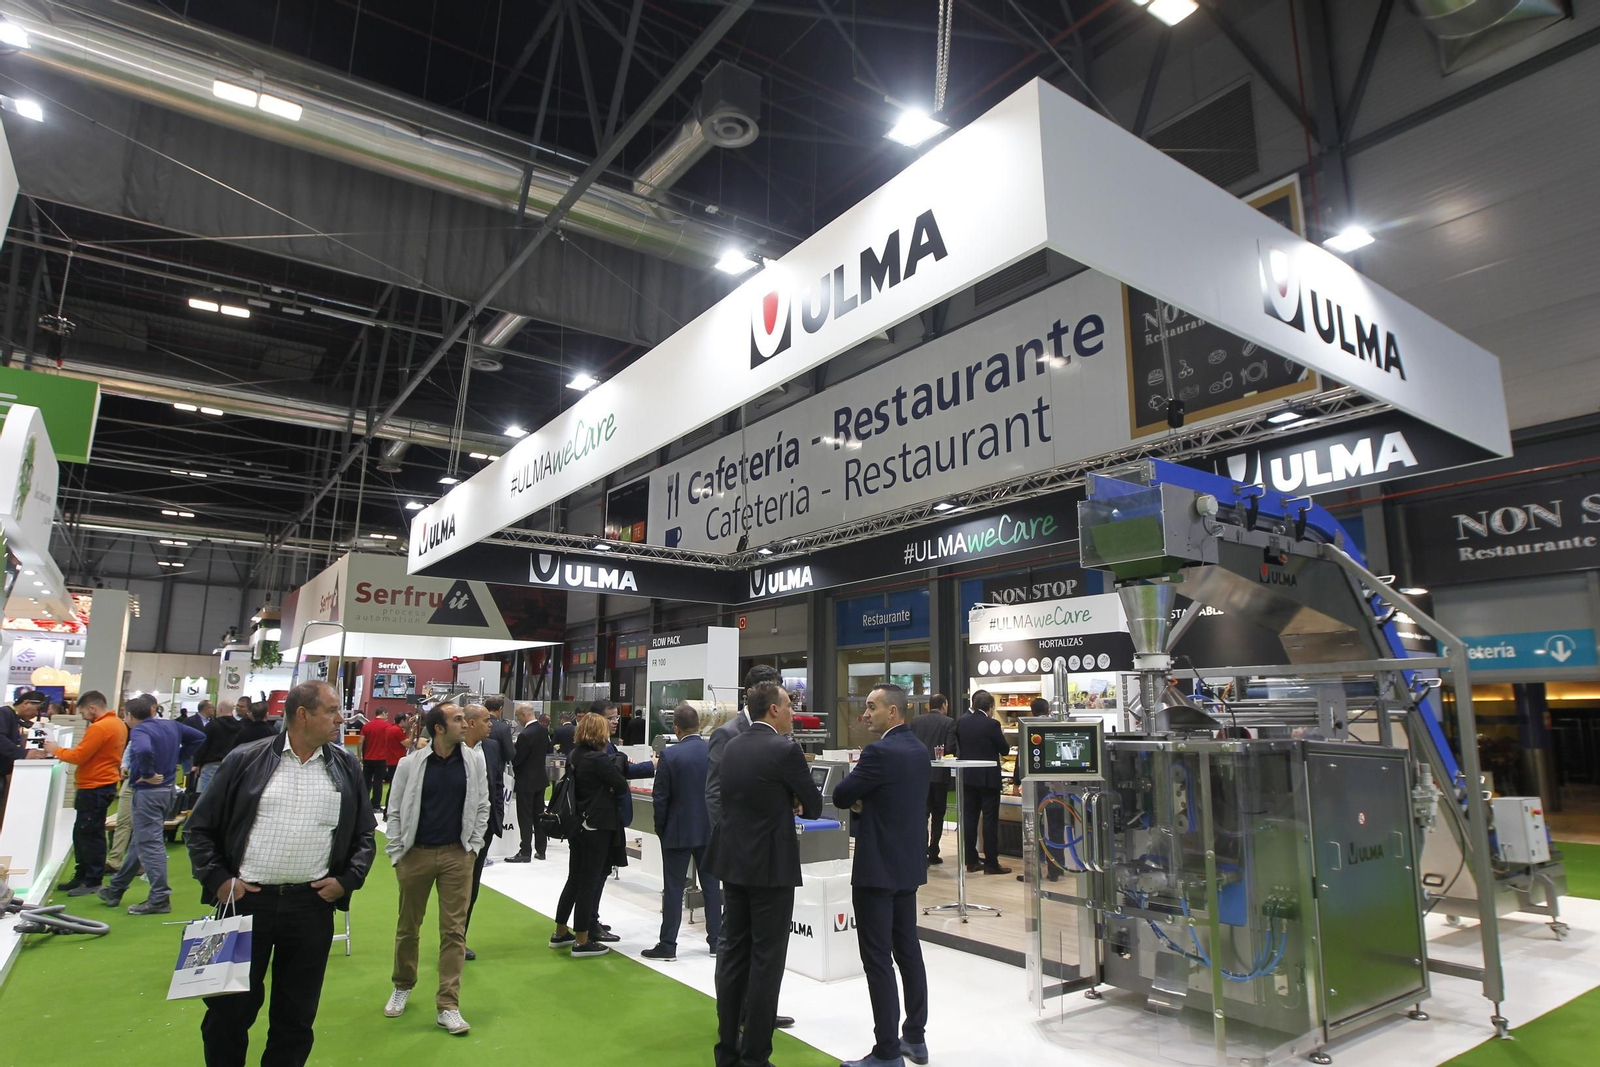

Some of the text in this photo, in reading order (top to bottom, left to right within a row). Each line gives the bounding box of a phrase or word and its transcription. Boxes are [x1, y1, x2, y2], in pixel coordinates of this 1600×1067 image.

[801, 209, 948, 334] ULMA
[1143, 303, 1189, 331] NO
[1311, 289, 1407, 381] ULMA
[687, 430, 800, 505] Cafetería
[833, 313, 1105, 450] Restaurante
[510, 413, 618, 498] #ULMAweCare
[705, 478, 810, 542] Cafeteria
[845, 395, 1052, 501] Restaurant
[1270, 430, 1418, 492] ULMA
[429, 513, 456, 550] ULMA
[1452, 500, 1562, 540] NON
[904, 512, 1058, 565] #ULMAweCare
[1458, 535, 1597, 561] Restaurante
[565, 564, 638, 592] ULMA
[768, 565, 813, 594] ULMA
[991, 579, 1078, 604] NON STOP
[1271, 571, 1298, 587] ULMA
[355, 614, 421, 624] automation
[382, 608, 426, 617] process
[862, 609, 911, 627] Restaurante
[989, 605, 1093, 631] #ULMAweCare
[652, 637, 667, 647] FLOW
[667, 635, 681, 646] PACK
[979, 643, 1004, 653] FRUTAS
[1039, 637, 1084, 649] HORTALIZAS
[658, 658, 667, 667] 100
[1359, 844, 1384, 862] ULMA
